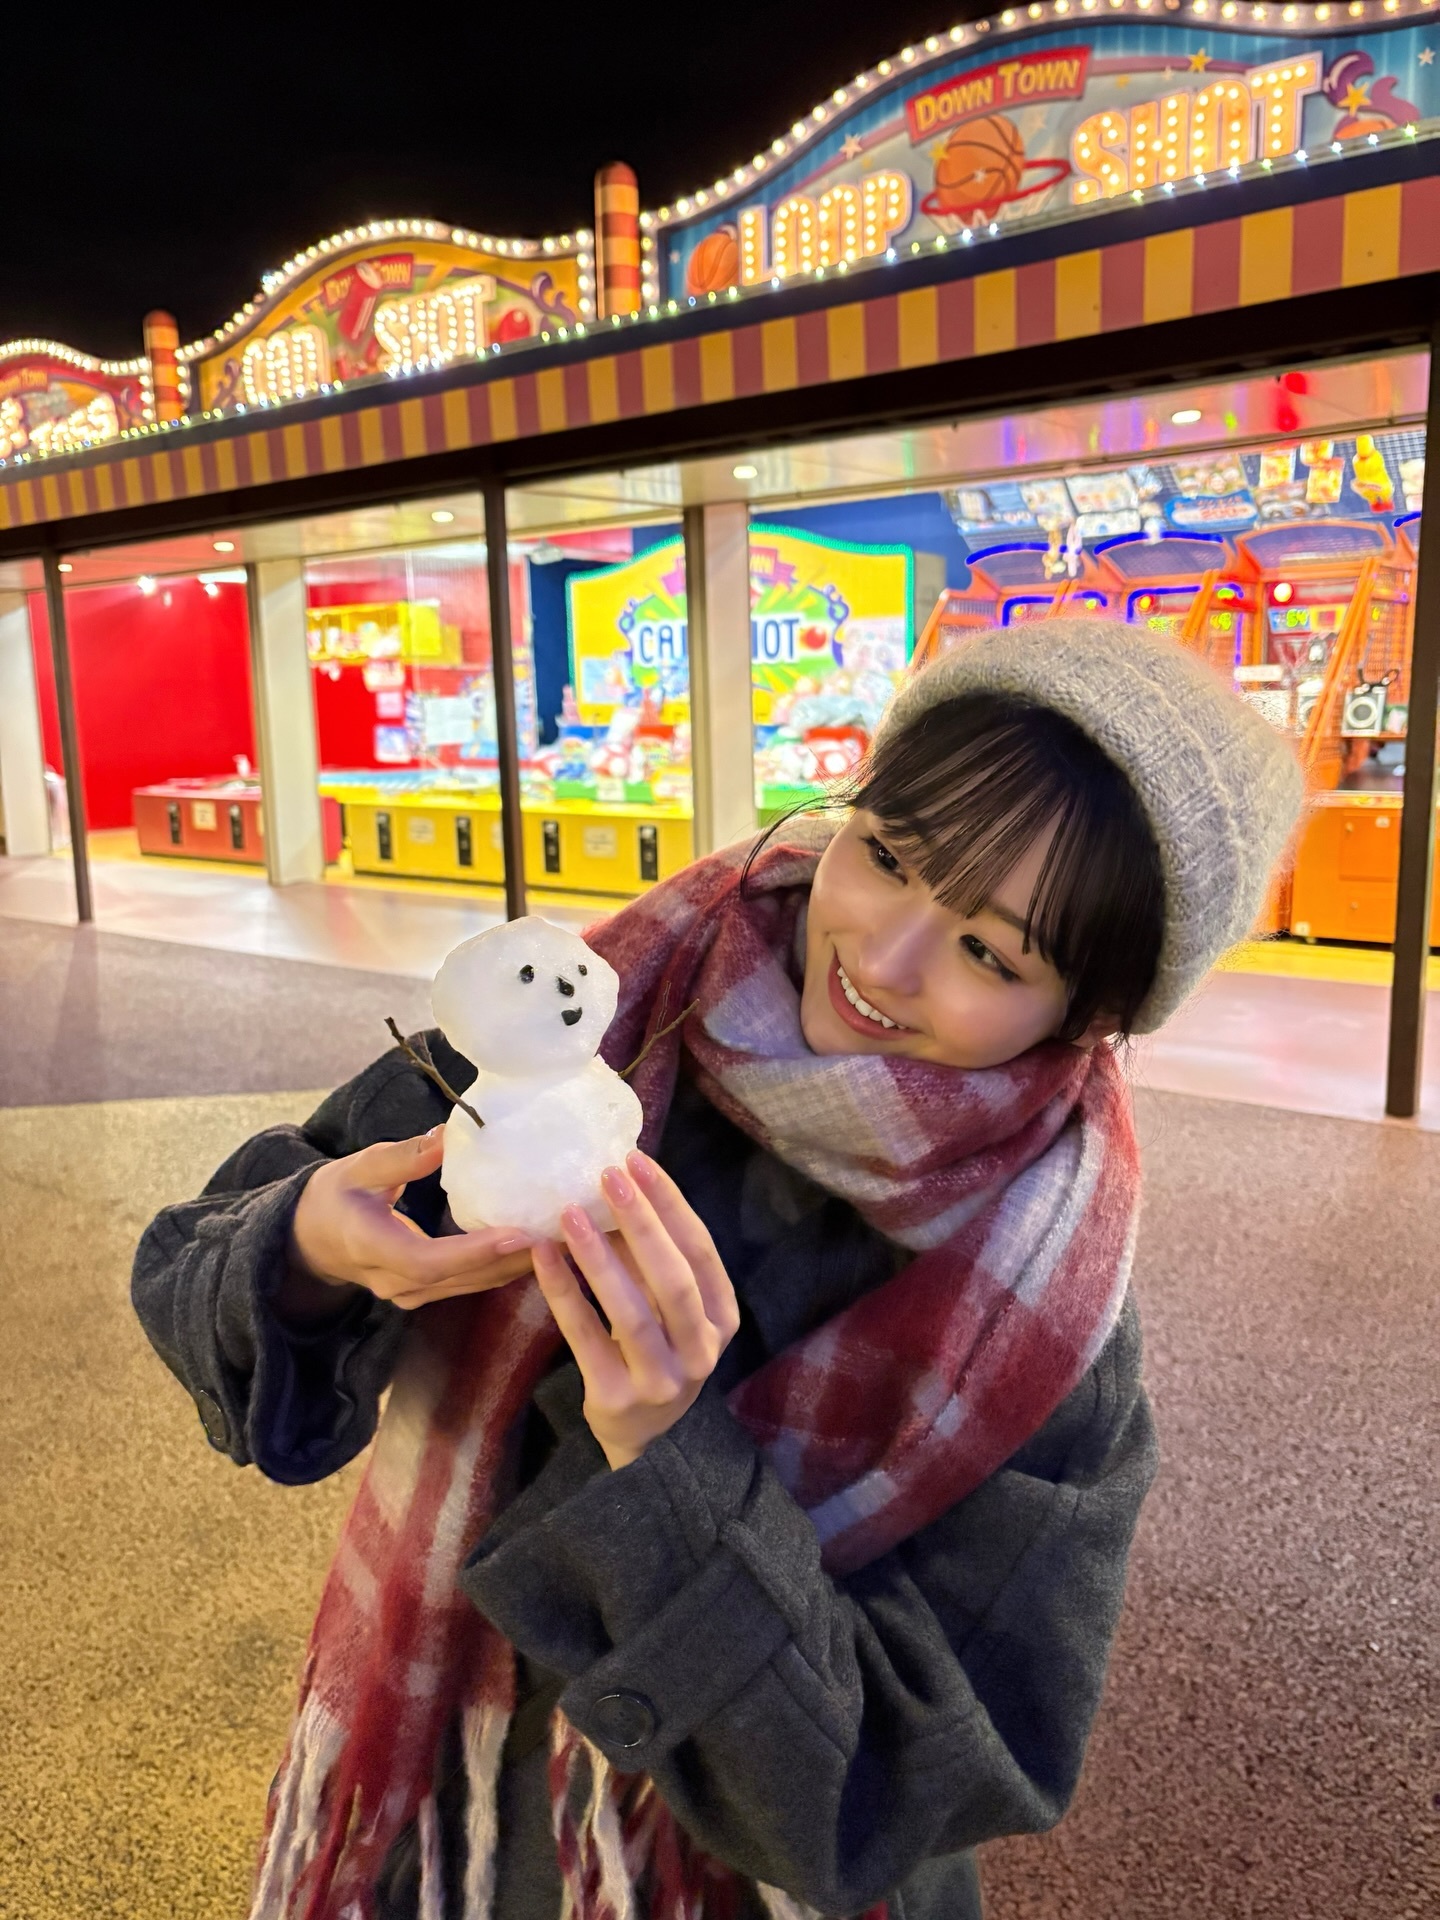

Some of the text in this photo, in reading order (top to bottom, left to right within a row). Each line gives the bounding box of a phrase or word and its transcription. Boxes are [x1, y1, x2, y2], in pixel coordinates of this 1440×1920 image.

[914, 59, 1081, 132] DOWN TOWN
[738, 53, 1321, 286] LOOP SHOT
[242, 276, 496, 404] CAN SHOT
